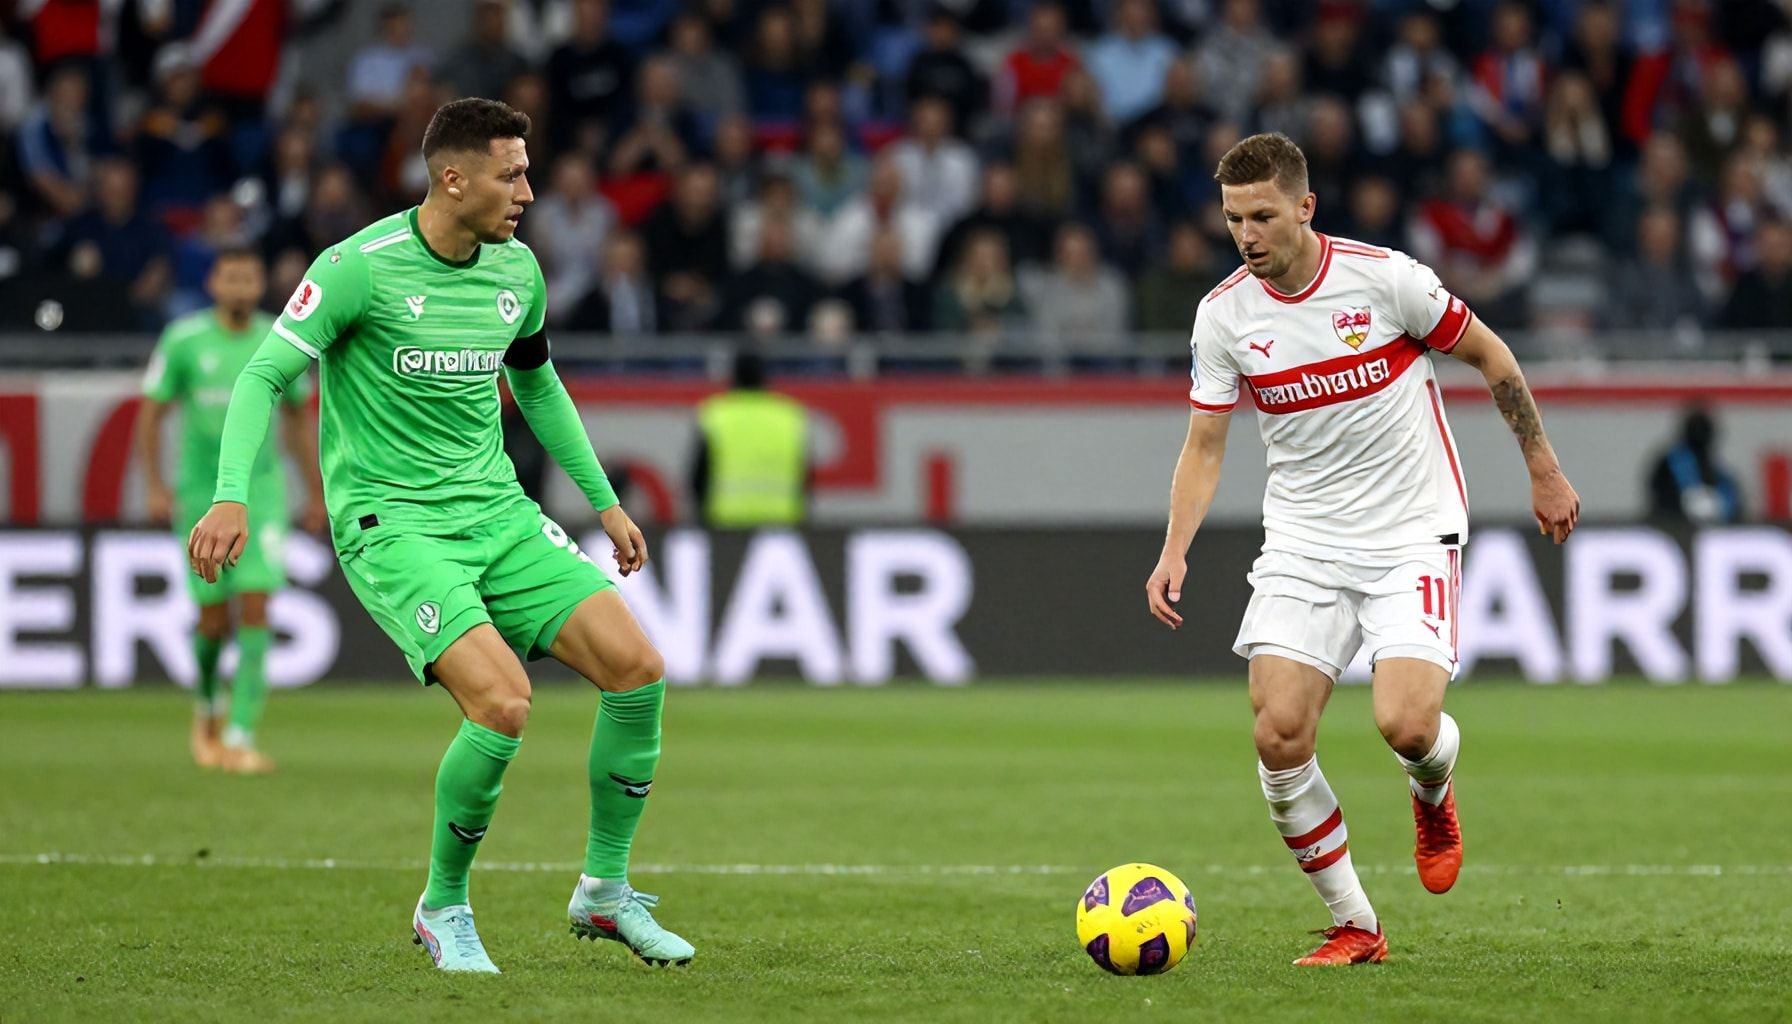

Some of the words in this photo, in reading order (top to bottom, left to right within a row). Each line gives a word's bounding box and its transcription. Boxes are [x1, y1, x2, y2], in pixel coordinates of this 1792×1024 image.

[0, 531, 341, 688] ERS
[1338, 528, 1792, 685] ARR
[1416, 575, 1445, 620] 11
